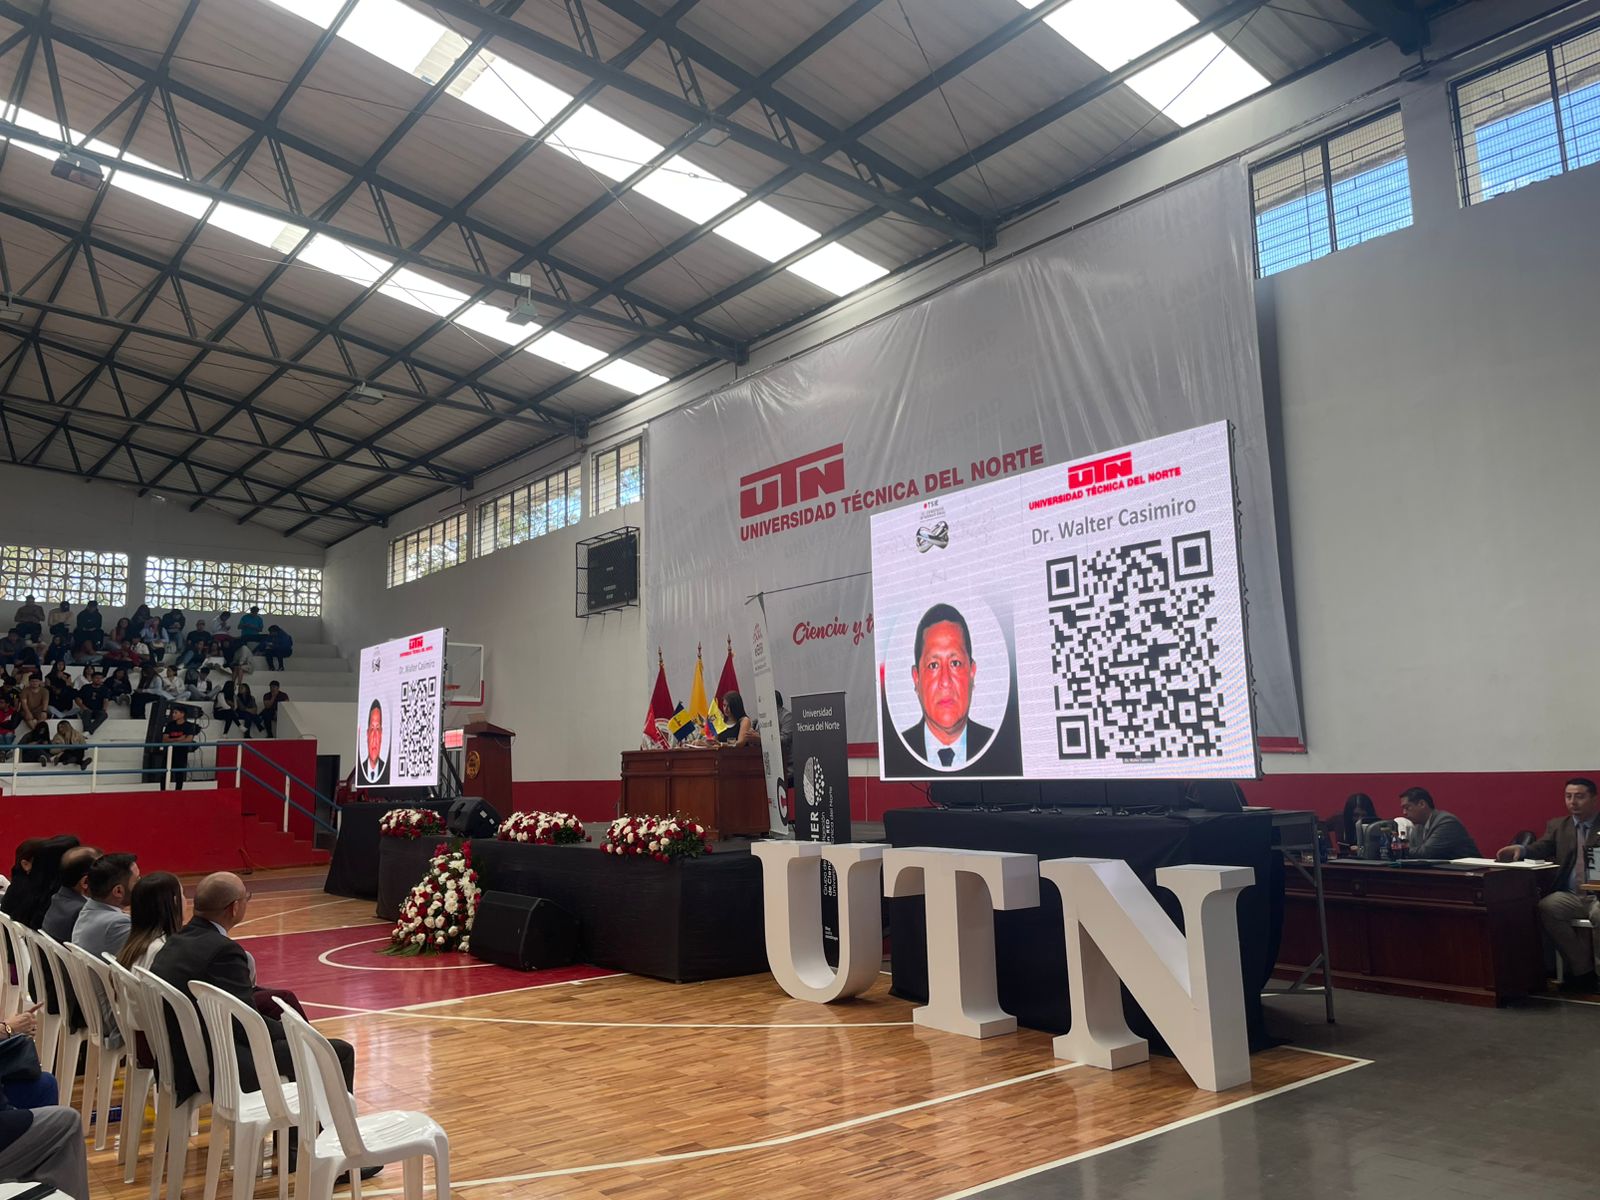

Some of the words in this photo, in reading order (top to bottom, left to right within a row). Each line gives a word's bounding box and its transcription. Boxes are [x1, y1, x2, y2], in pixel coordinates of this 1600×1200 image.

[740, 442, 845, 519] UTN
[1028, 490, 1084, 511] UNIVERSIDAD
[1086, 479, 1125, 499] TÉCNICA
[1127, 475, 1146, 489] DEL
[1148, 466, 1182, 484] NORTE
[1067, 451, 1133, 489] UTN
[740, 501, 837, 542] UNIVERSIDAD
[841, 479, 919, 514] TÉCNICA
[924, 467, 964, 494] DEL
[970, 443, 1044, 481] NORTE
[1032, 526, 1054, 545] Dr.
[1058, 516, 1114, 540] Walter
[1118, 499, 1197, 527] Casimiro
[409, 635, 423, 650] UTN
[792, 616, 849, 645] Ciencia
[852, 620, 865, 646] y
[796, 720, 815, 732] Técnica
[815, 720, 824, 732] del
[824, 720, 840, 731] Norte
[802, 707, 833, 718] Universidad
[750, 840, 1257, 1092] UTN
